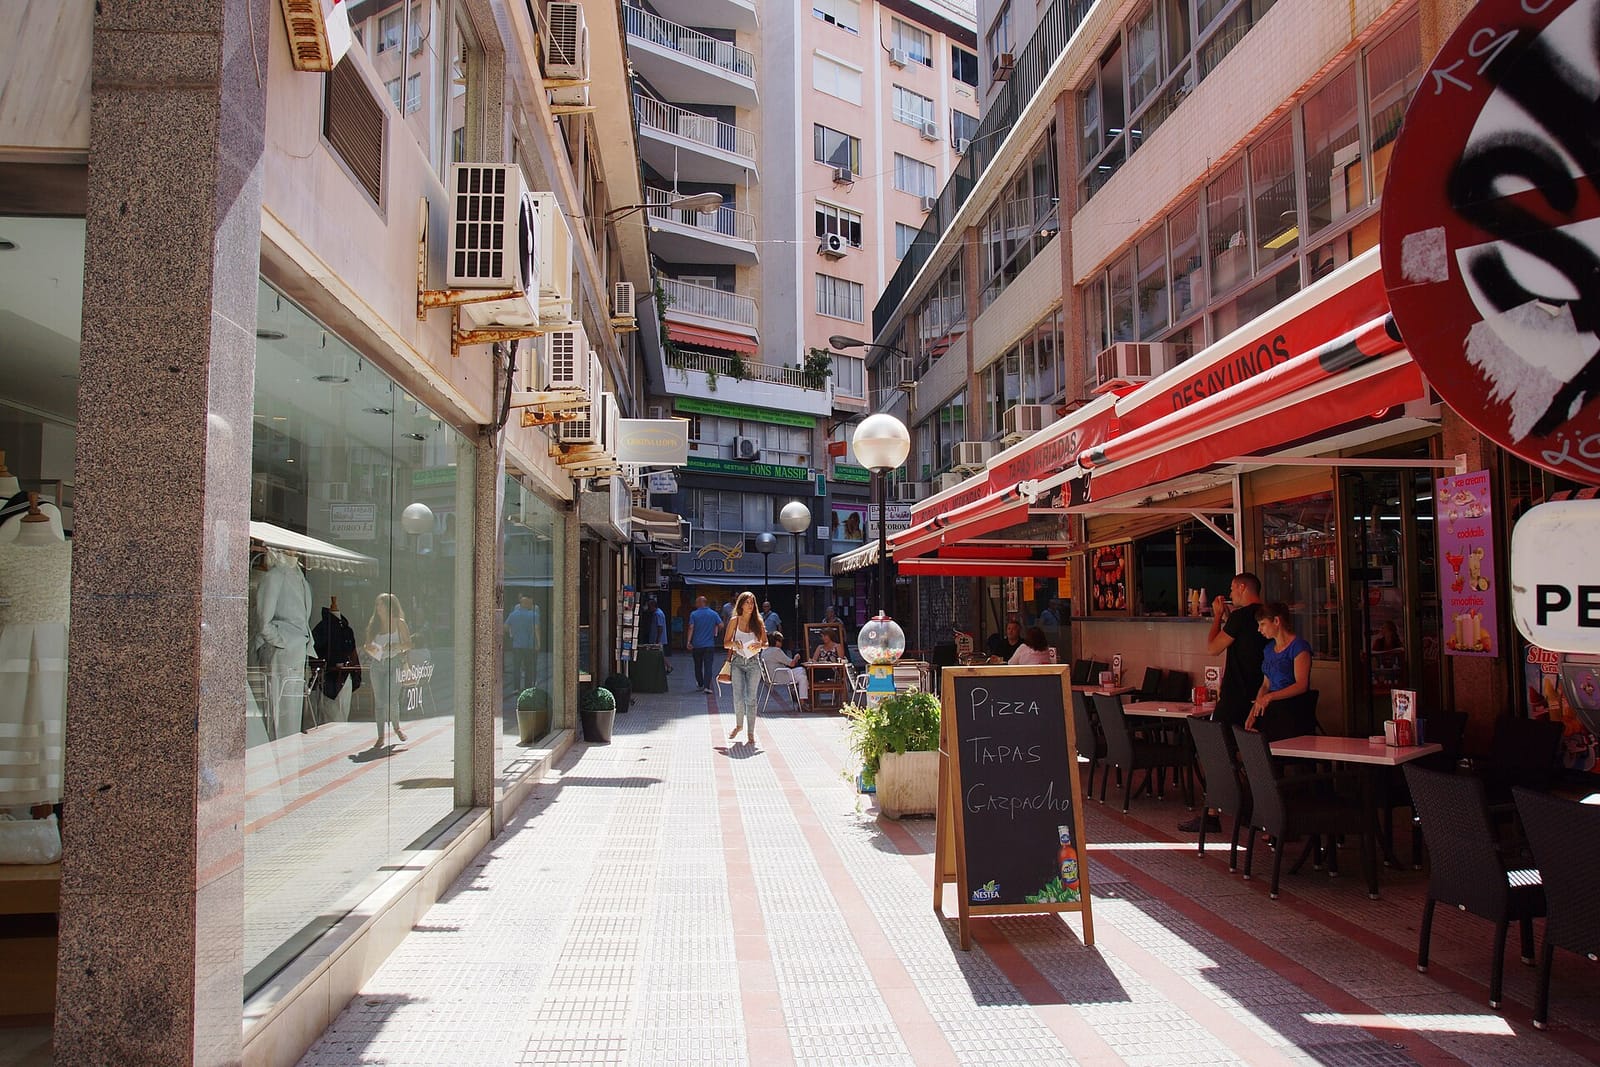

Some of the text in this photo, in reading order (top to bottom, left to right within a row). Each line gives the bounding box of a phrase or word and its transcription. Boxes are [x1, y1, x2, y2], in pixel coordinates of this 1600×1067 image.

[1172, 334, 1291, 412] DESAYUNOS
[750, 463, 771, 477] FONS
[774, 466, 807, 480] MASSIP
[974, 890, 1000, 899] NESTEA
